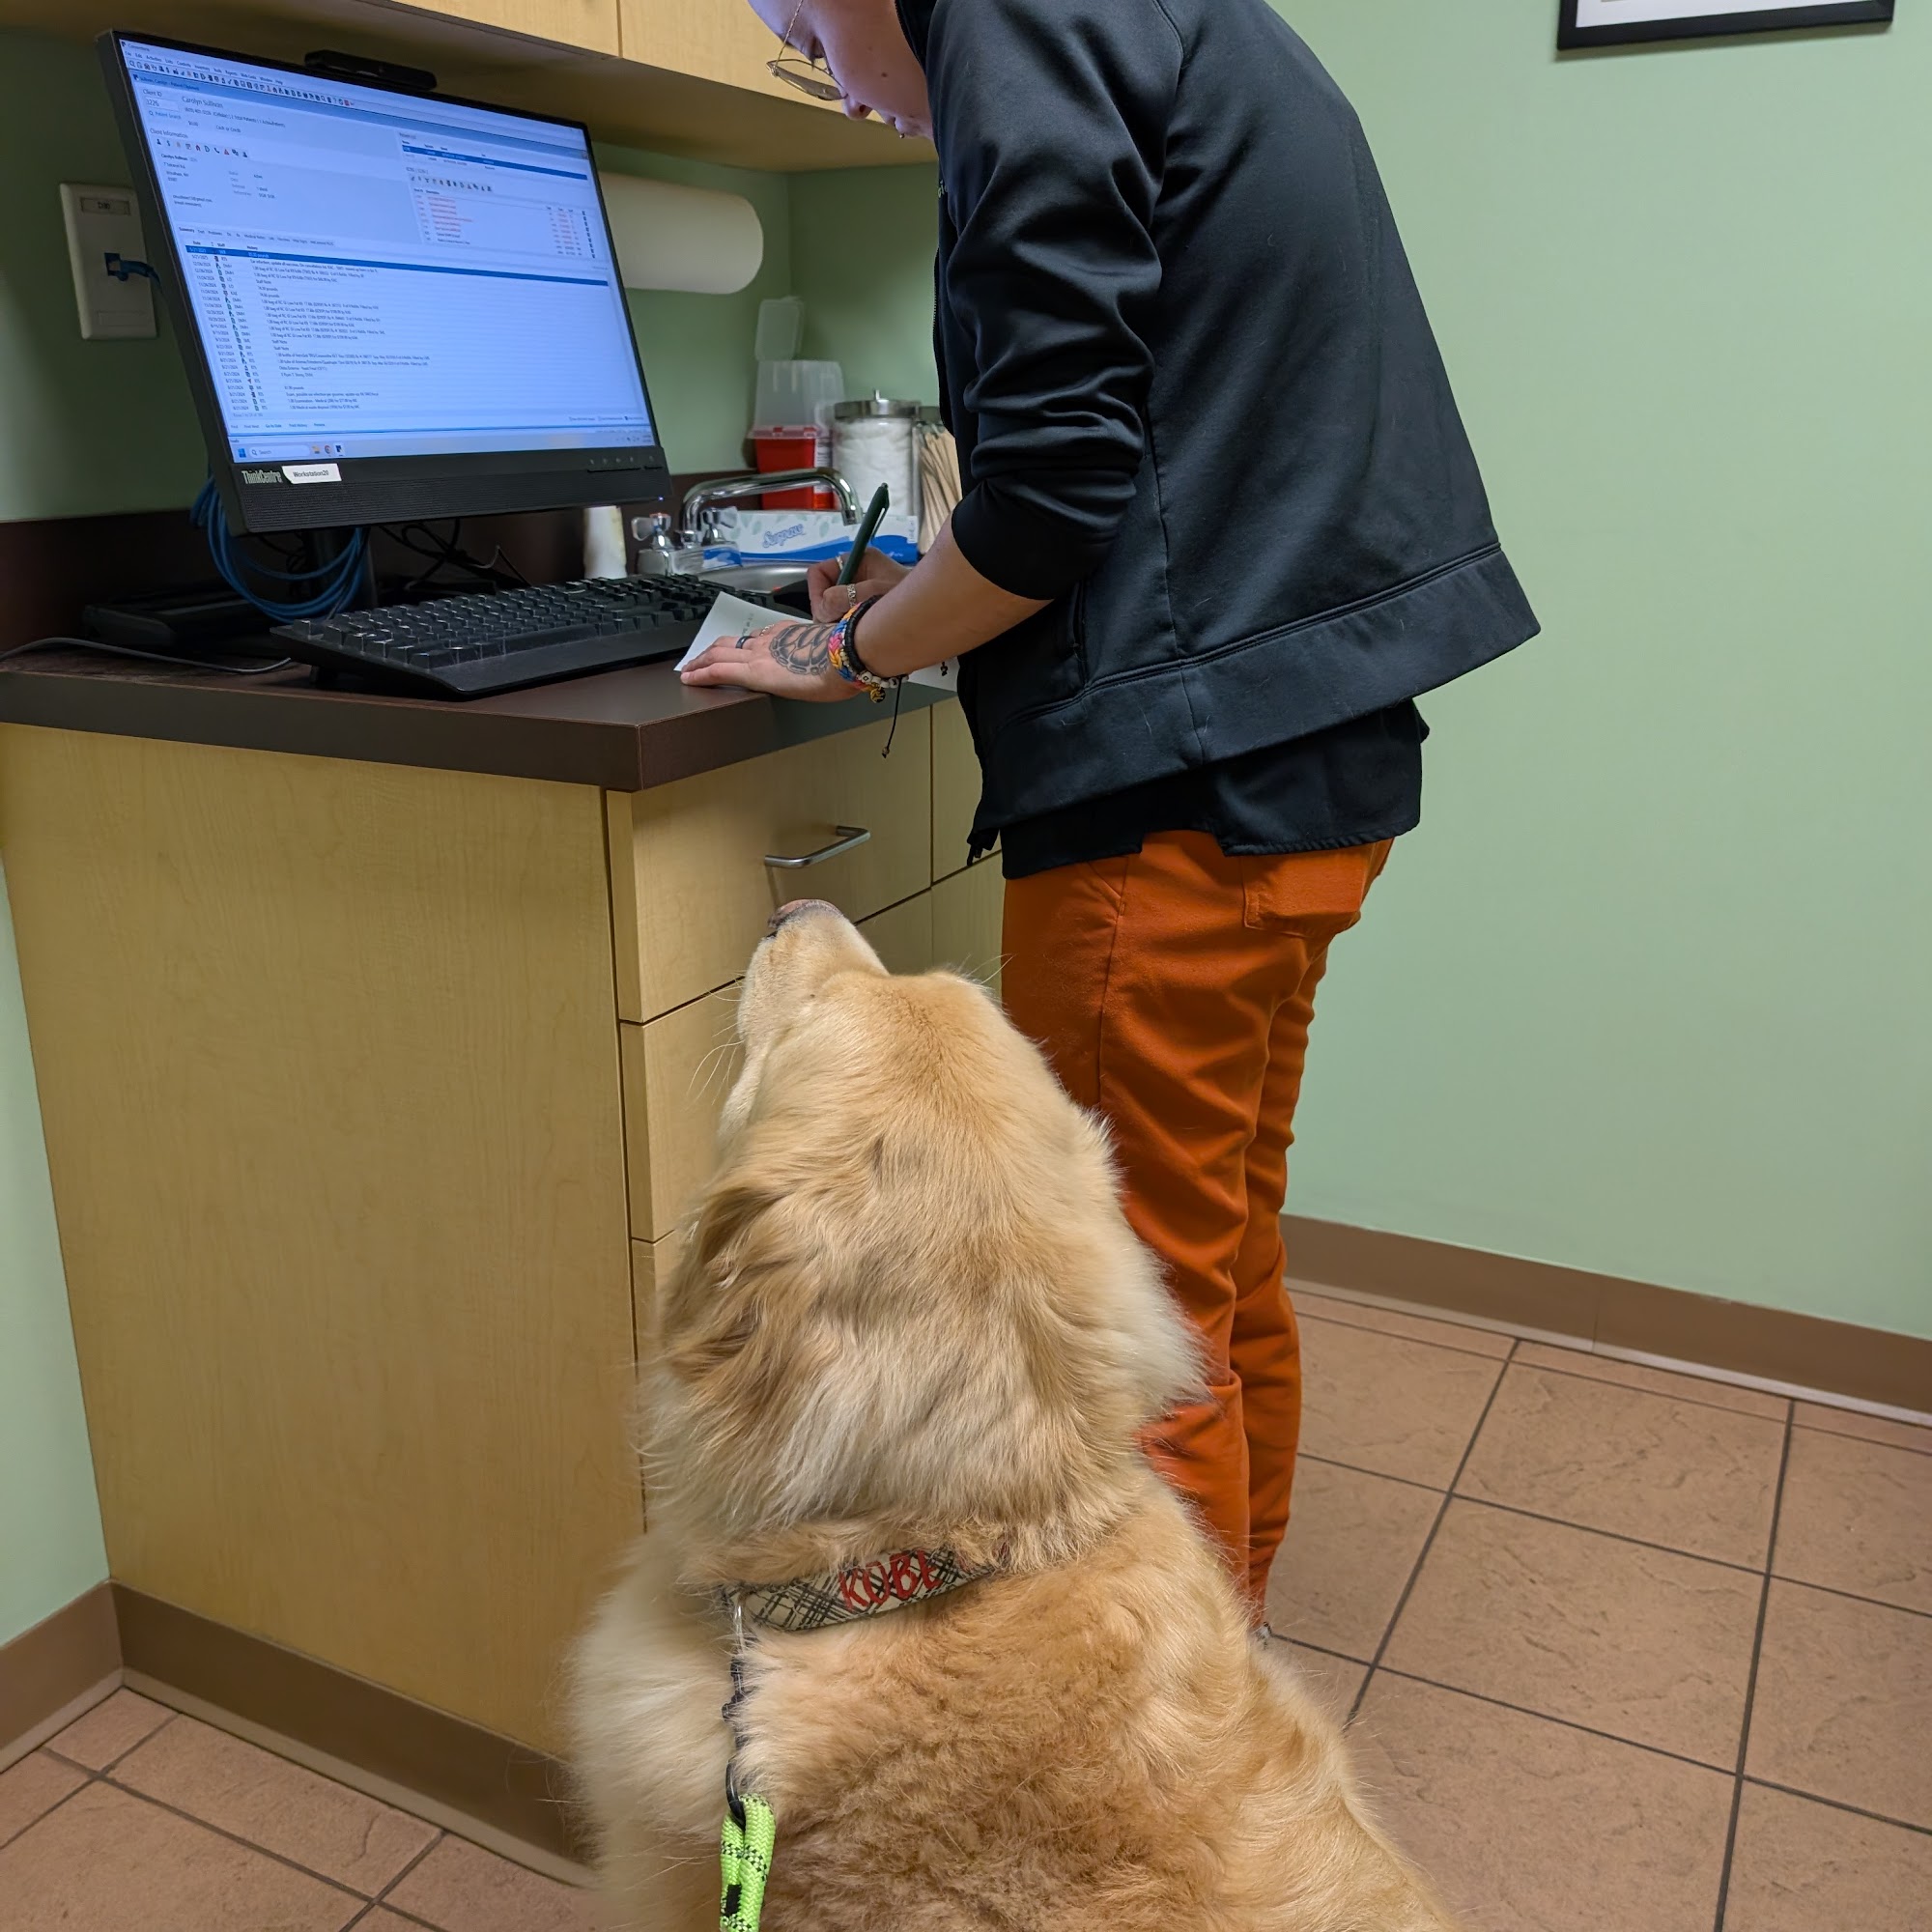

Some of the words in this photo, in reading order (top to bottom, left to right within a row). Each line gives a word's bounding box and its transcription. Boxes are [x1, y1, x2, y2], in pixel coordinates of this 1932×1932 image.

[182, 97, 202, 106] Carolyn
[163, 129, 187, 138] Information
[242, 469, 284, 485] ThinkCentre
[838, 1548, 943, 1611] KOBE
